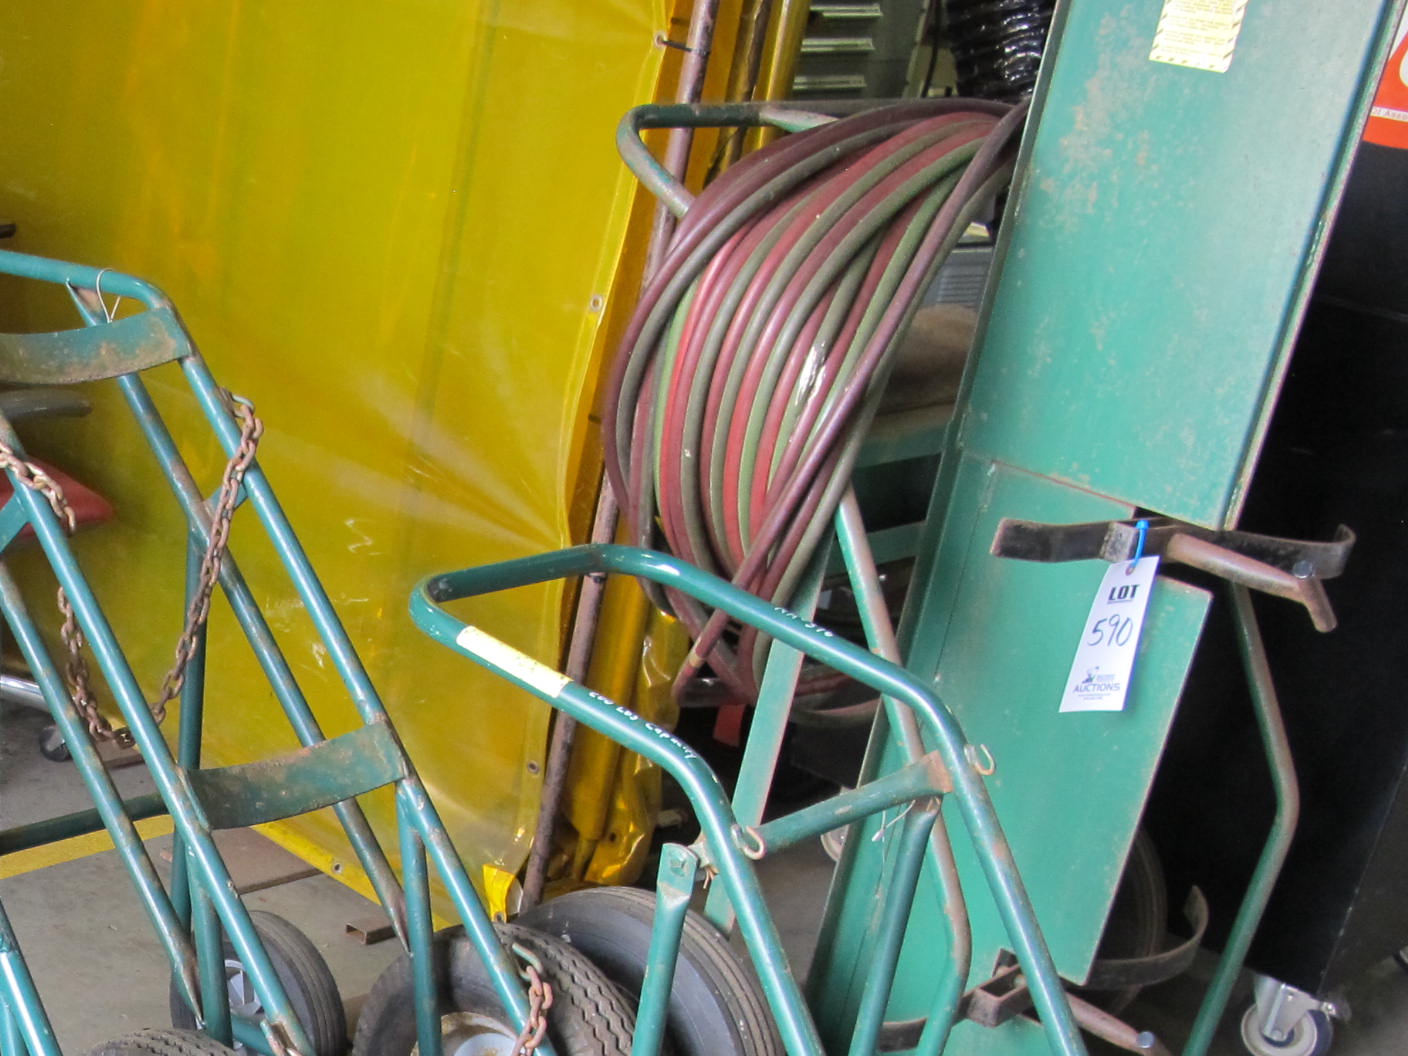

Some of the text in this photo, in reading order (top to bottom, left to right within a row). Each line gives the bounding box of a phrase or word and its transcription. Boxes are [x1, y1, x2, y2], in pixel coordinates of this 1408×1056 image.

[1109, 584, 1140, 601] LOT
[1087, 614, 1132, 646] 590
[1073, 682, 1120, 692] AUCTIONS
